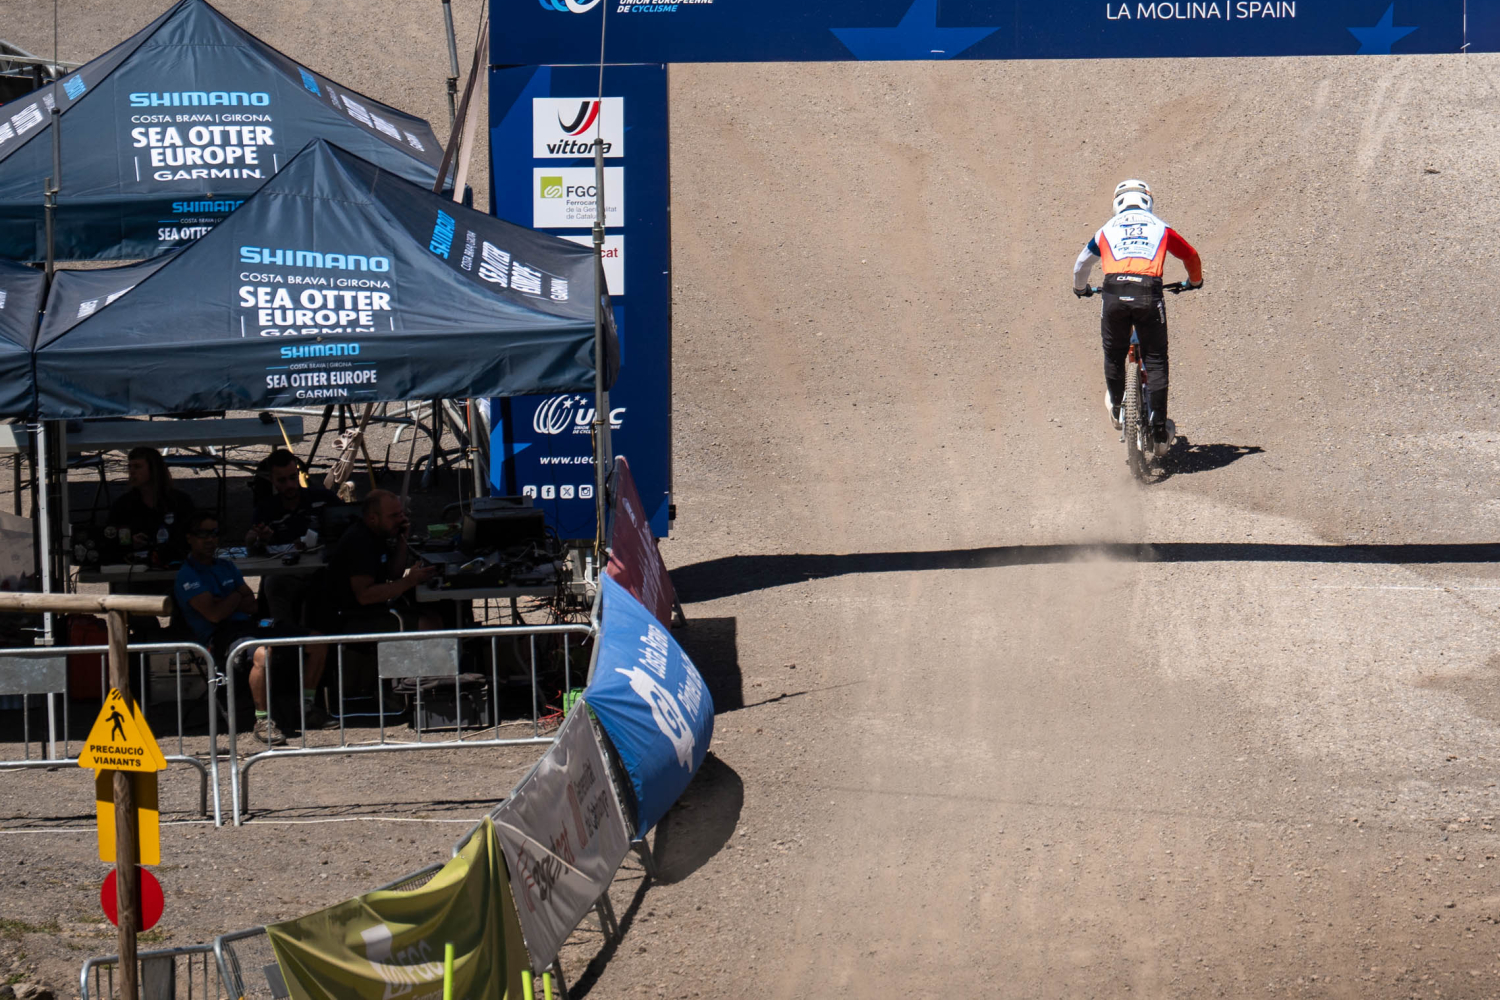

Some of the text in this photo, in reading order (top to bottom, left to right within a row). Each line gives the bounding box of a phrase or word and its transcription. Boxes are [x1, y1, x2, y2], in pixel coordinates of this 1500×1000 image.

[617, 4, 678, 14] DE CYCLISME
[1106, 1, 1296, 20] LA MOLINA SPAIN
[129, 91, 270, 108] SHIMANO
[131, 114, 272, 124] COSTA BRAVA GIRONA
[131, 126, 274, 148] SEA OTTER
[150, 146, 258, 167] EUROPE
[566, 186, 598, 198] FGC
[172, 200, 244, 213] SHIMAN
[158, 227, 179, 241] SEA
[1124, 226, 1144, 237] 123
[240, 246, 390, 272] SHIMANO
[240, 272, 390, 288] COSTA BRAVA GIRONA
[239, 286, 392, 310] SEA OTTER
[258, 309, 374, 326] EUROPE
[280, 343, 360, 358] SHIMANO
[266, 370, 377, 389] SEA OTTER EUROPE
[296, 388, 348, 399] GARMIN
[90, 744, 144, 756] PRECAUCIÓ
[94, 756, 142, 767] VIANANTS
